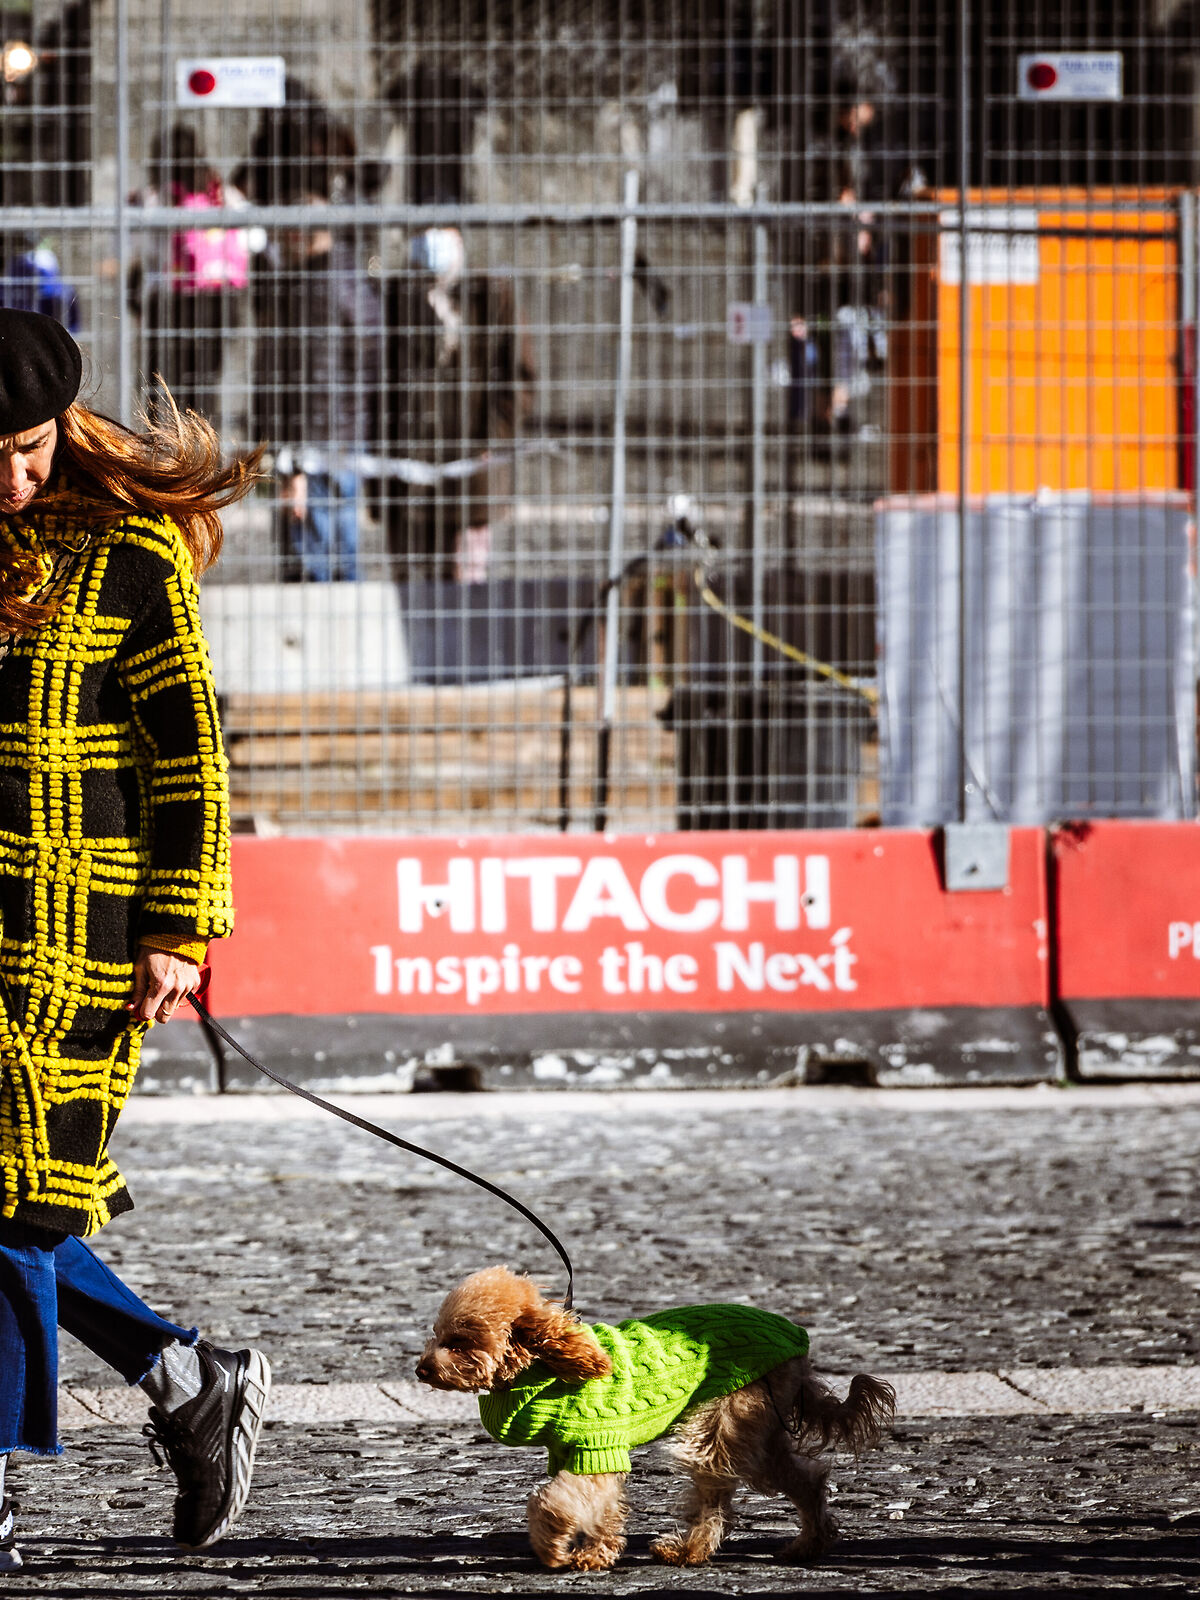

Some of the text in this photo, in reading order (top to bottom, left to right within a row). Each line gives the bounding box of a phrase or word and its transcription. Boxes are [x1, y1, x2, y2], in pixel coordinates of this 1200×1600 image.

[397, 854, 831, 933] HITACHI
[369, 927, 858, 1006] Inspire the Next
